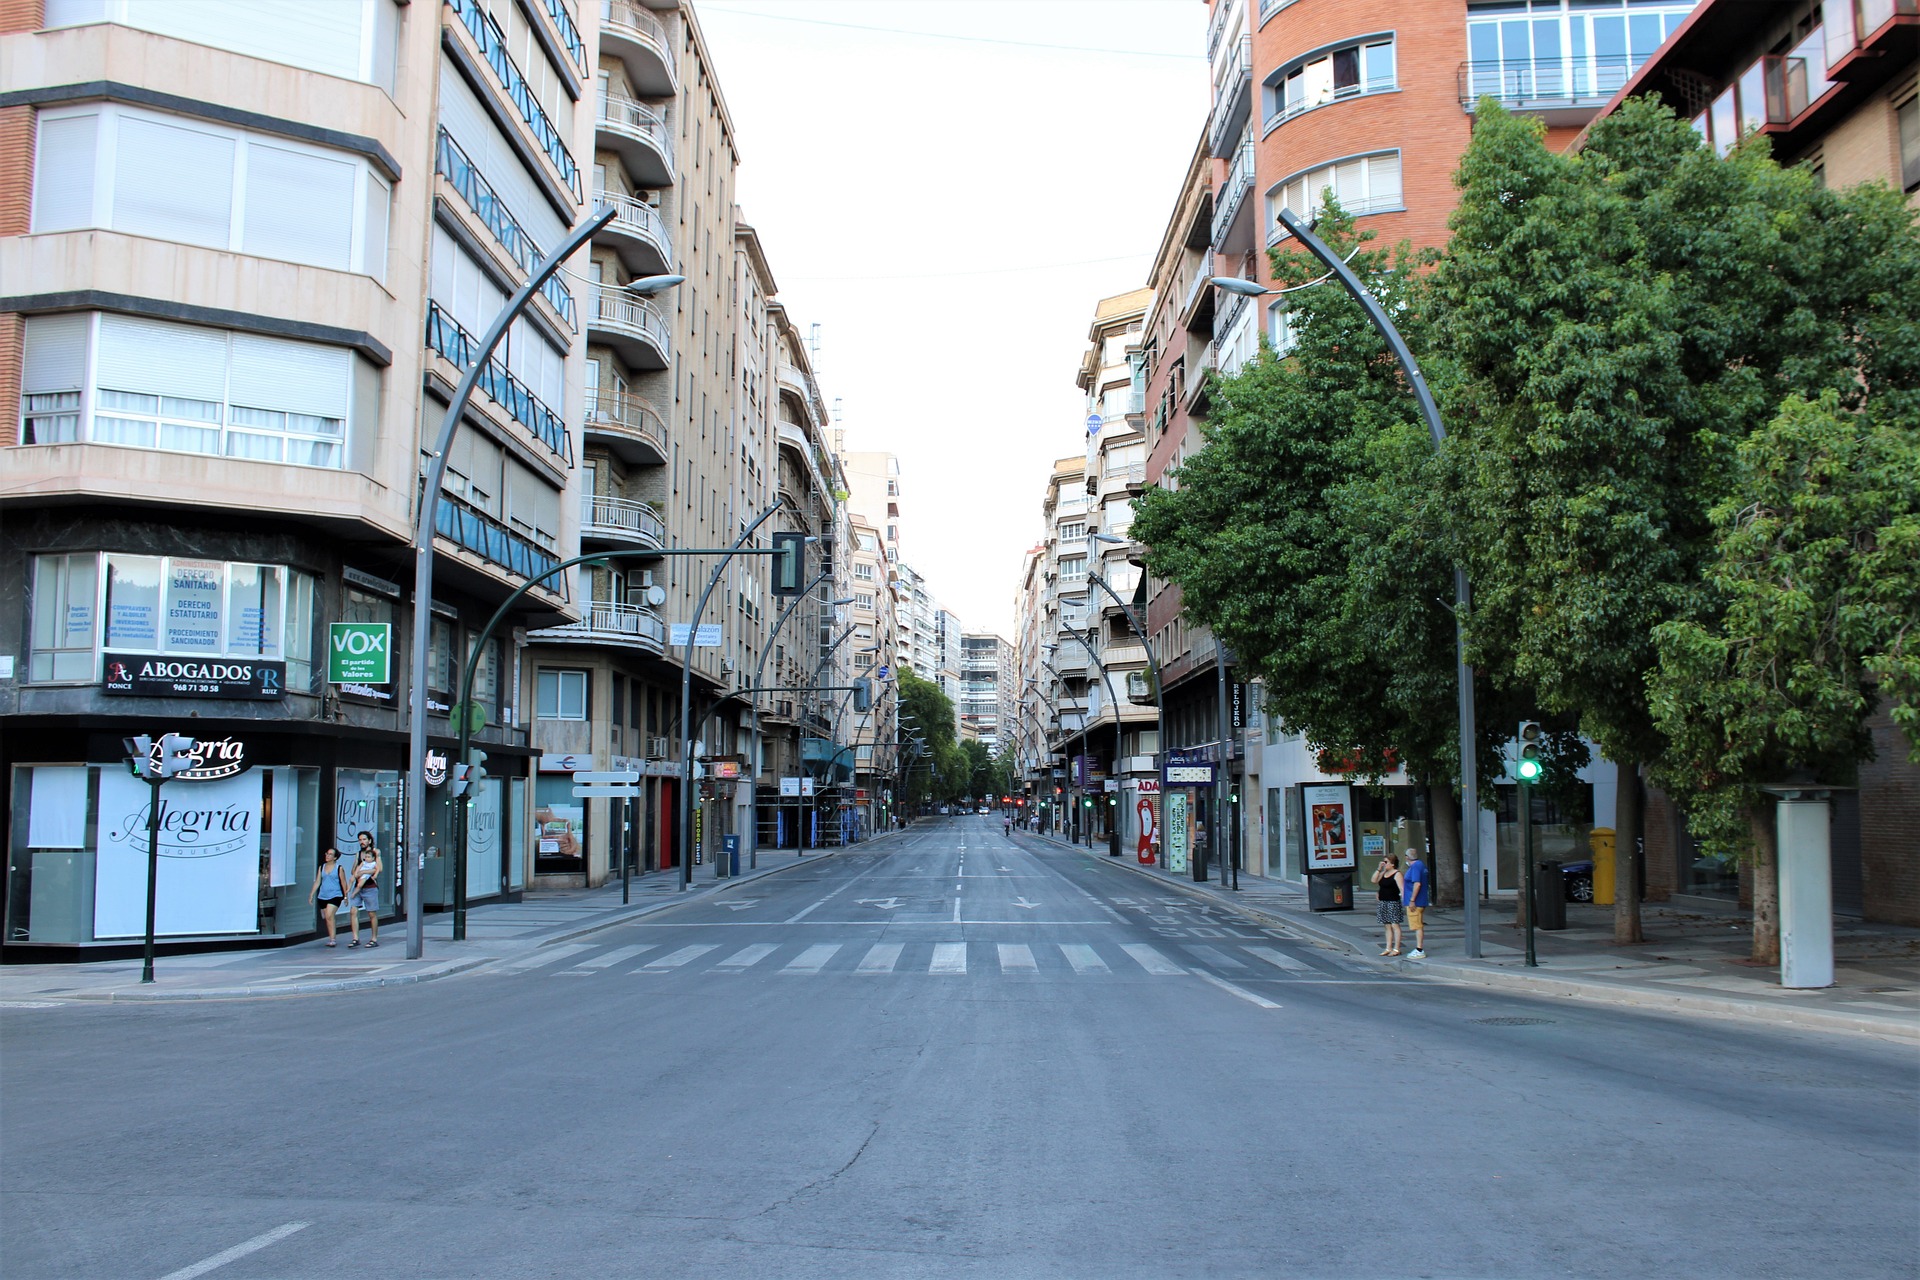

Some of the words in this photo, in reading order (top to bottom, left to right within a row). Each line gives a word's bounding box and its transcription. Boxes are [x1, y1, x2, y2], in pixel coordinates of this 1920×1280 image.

[177, 568, 214, 580] DERECHO
[173, 579, 217, 590] SANITARIO
[178, 600, 211, 610] DERECHO
[170, 609, 218, 620] ESTATUTARIO
[168, 628, 219, 638] PROCEDIMIENTO
[171, 637, 215, 646] SANCIONADOR
[333, 628, 384, 655] VOX
[350, 659, 375, 667] partido
[139, 661, 252, 680] ABOGADOS
[173, 684, 187, 692] 968
[188, 684, 197, 692] 71
[209, 685, 219, 693] 58
[109, 799, 250, 843] Alegría
[129, 838, 245, 855] PEUQUEROS
[1109, 897, 1204, 905] BICI
[1128, 905, 1239, 915] TAXI
[1149, 915, 1258, 925] BUS
[1150, 927, 1303, 940] SOLO
